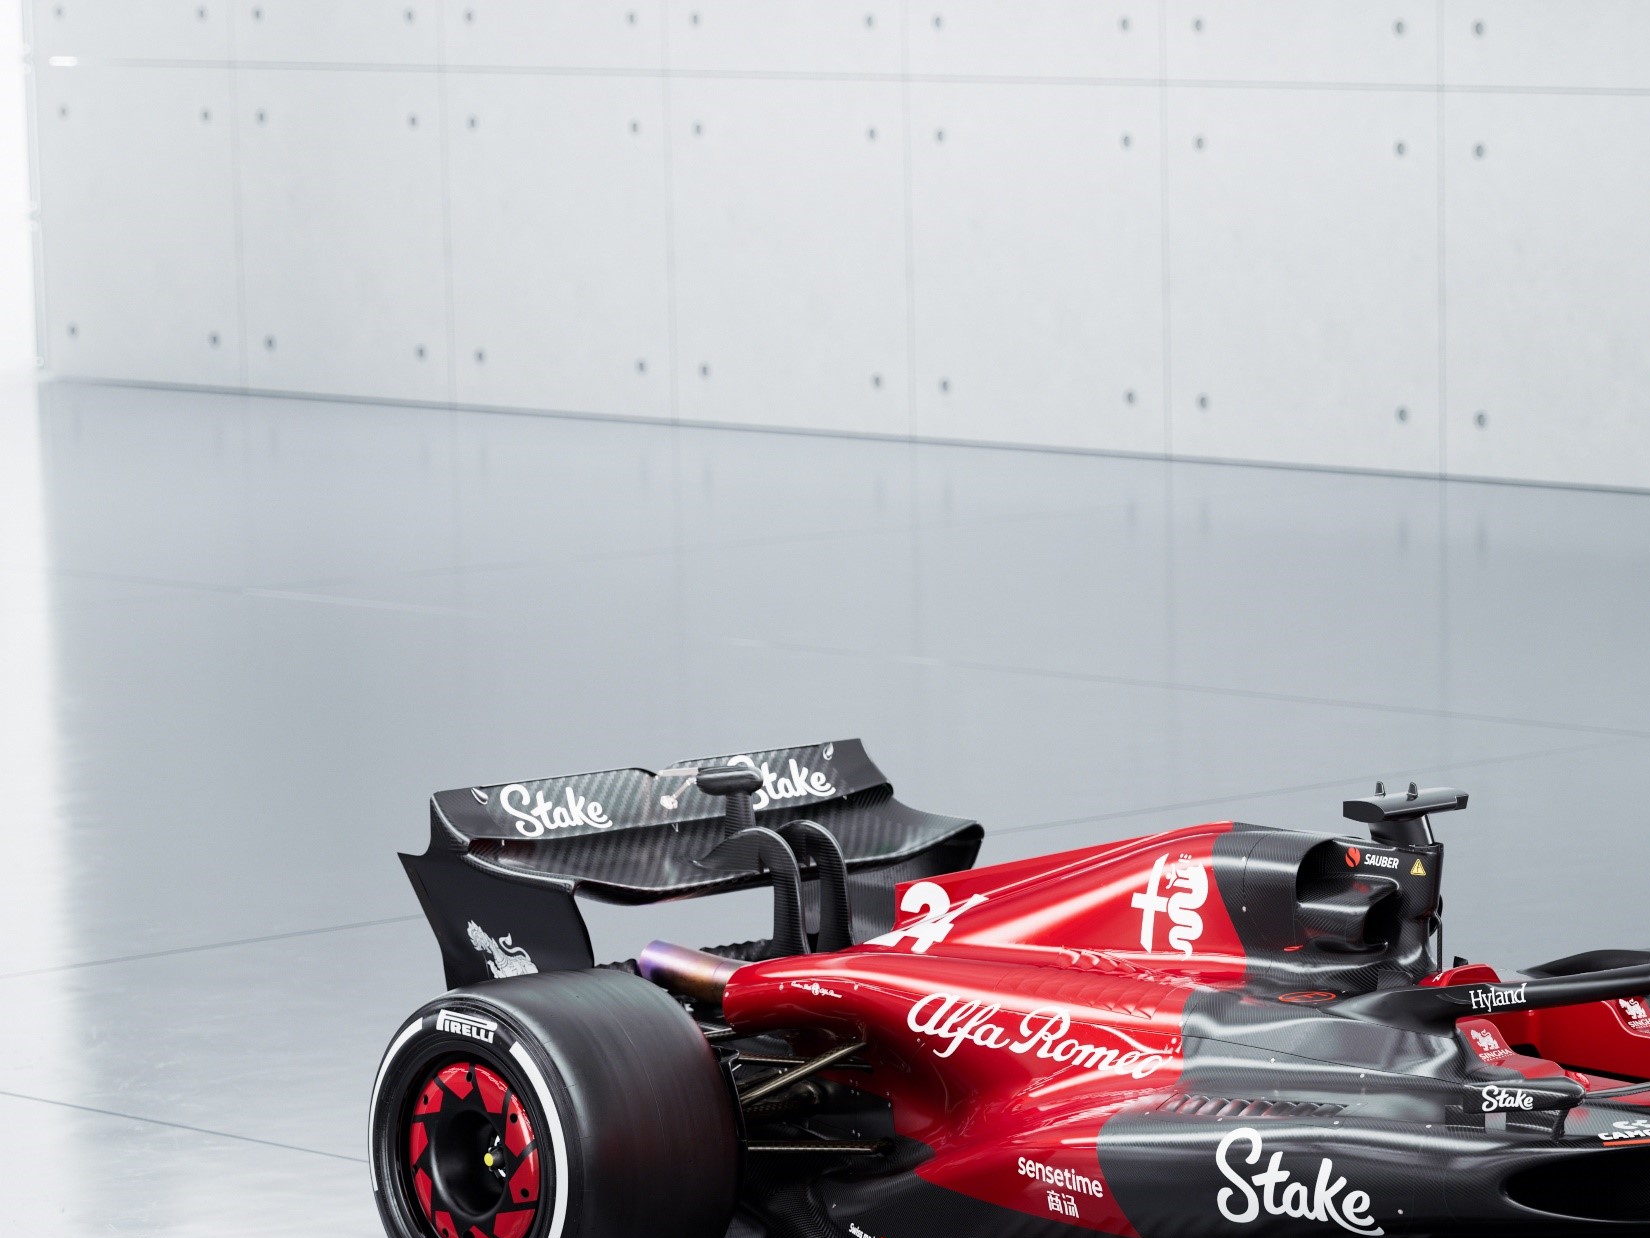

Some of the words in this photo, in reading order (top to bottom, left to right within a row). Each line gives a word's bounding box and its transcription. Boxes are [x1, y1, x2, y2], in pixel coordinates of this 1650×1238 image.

[500, 784, 613, 837] Stake
[1364, 854, 1399, 869] SAUBER
[1469, 982, 1528, 1012] Hyland
[436, 1008, 498, 1044] PIRELLI
[907, 992, 1010, 1058] Alfa
[1008, 1005, 1174, 1079] Romeo
[1478, 1049, 1513, 1060] SINGHA
[1481, 1085, 1534, 1112] Stake
[1018, 1156, 1104, 1198] sensetime
[1215, 1127, 1385, 1236] Stake
